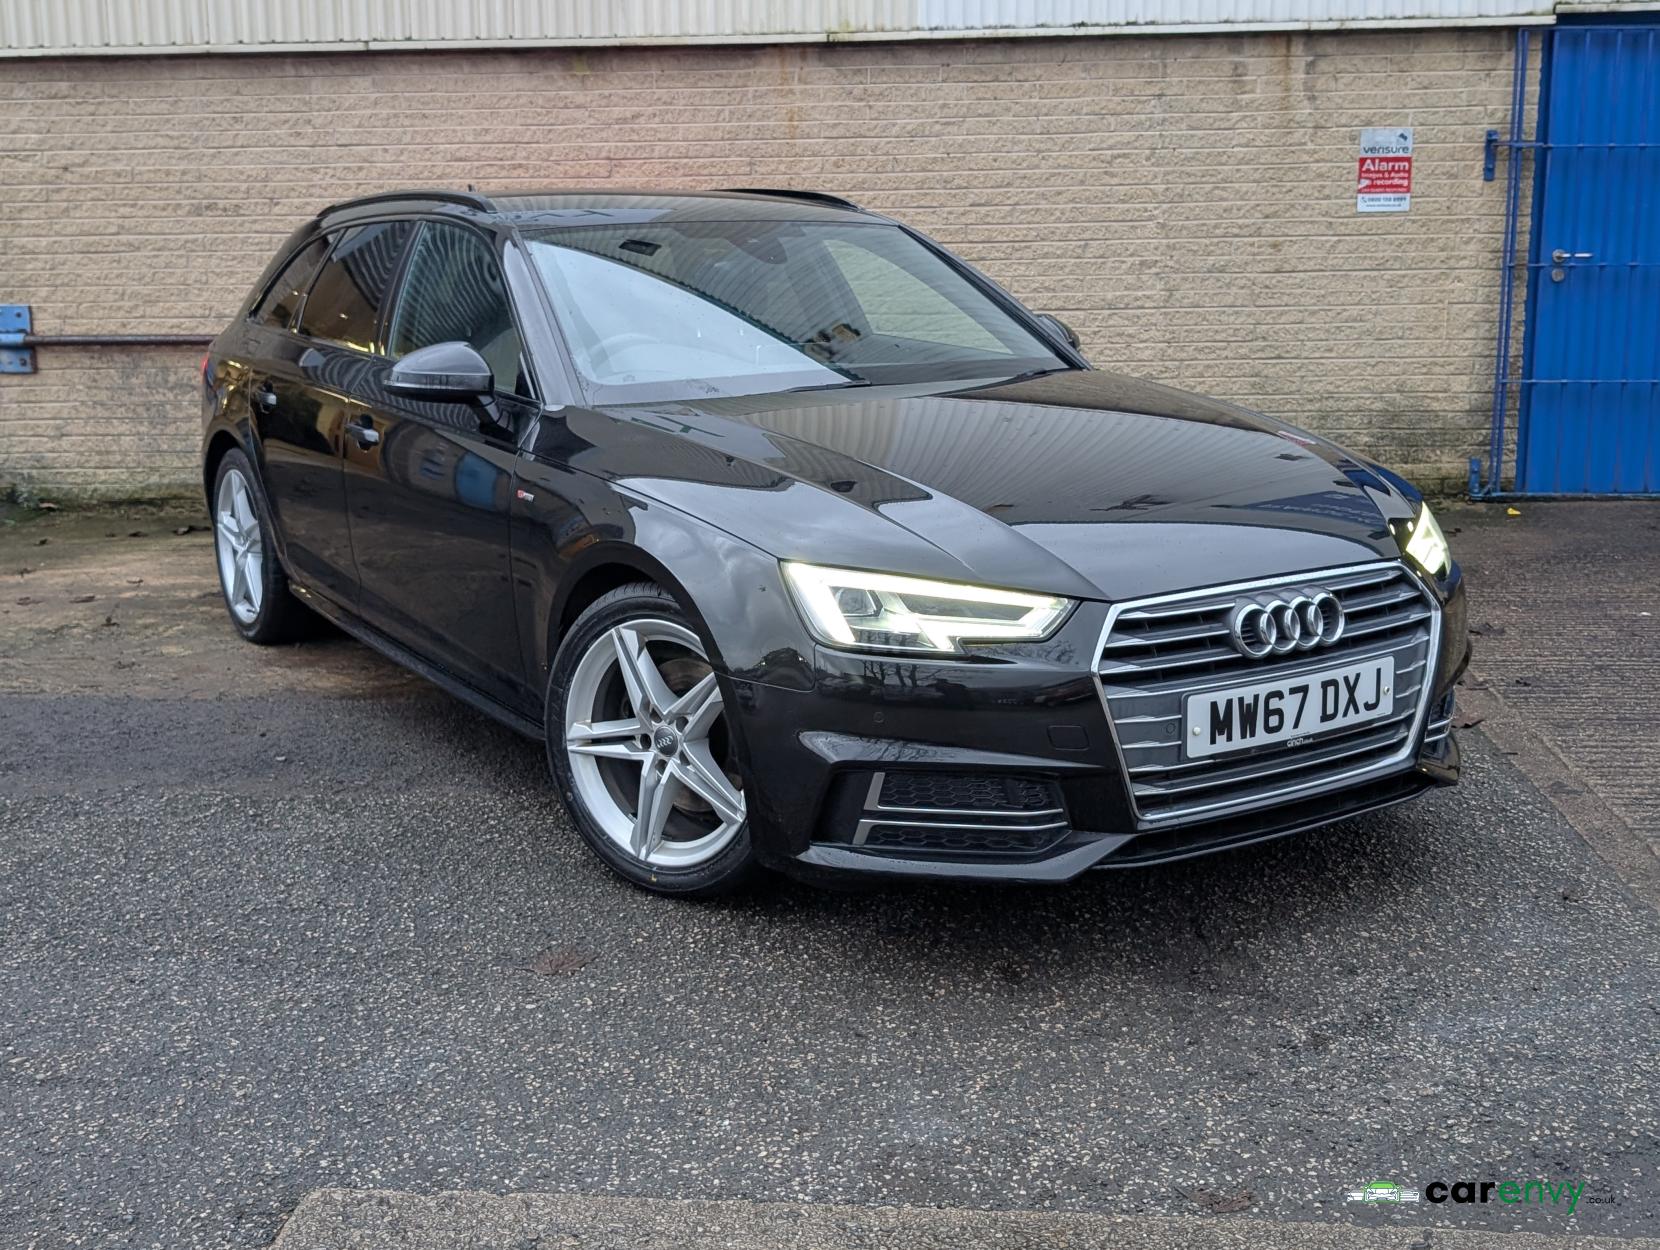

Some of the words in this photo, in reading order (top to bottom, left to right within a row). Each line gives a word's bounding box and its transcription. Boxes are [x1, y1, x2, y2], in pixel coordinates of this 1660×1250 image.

[1363, 146, 1409, 154] verisure
[1362, 159, 1409, 171] Alarm
[1209, 684, 1310, 745] MW67
[1320, 667, 1382, 723] DXJ
